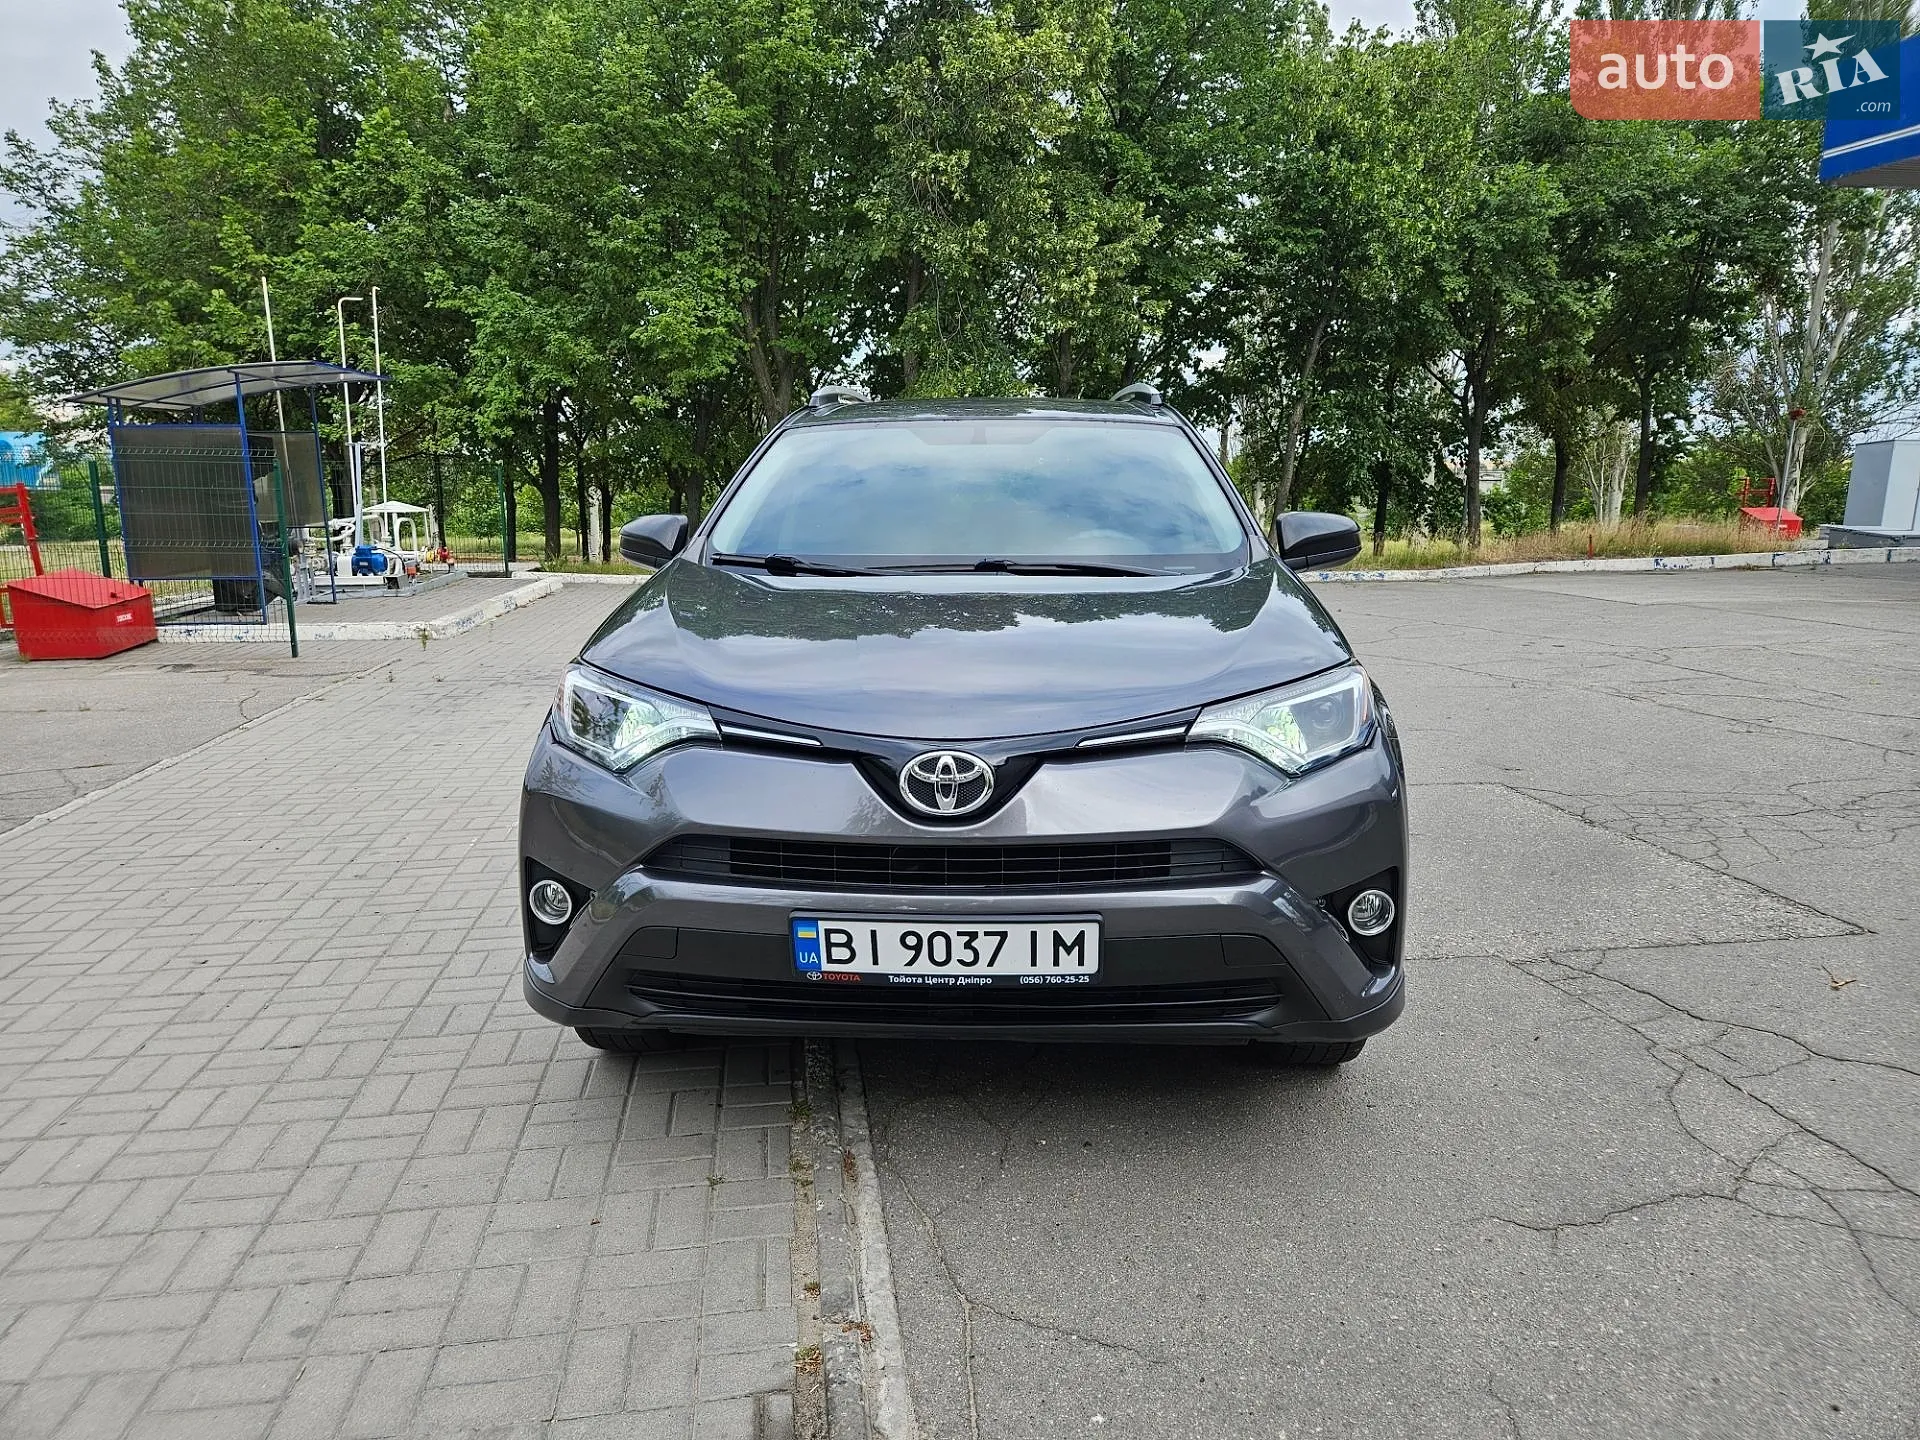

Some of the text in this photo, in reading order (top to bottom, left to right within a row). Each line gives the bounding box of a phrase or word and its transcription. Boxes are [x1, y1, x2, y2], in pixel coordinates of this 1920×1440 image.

[824, 928, 1085, 967] BI 9037 IM
[799, 951, 819, 964] UA
[822, 973, 861, 981] TOYOTA
[888, 975, 992, 986] Тойота Центр Дніпро
[1020, 975, 1090, 984] (056) 760-25-25
